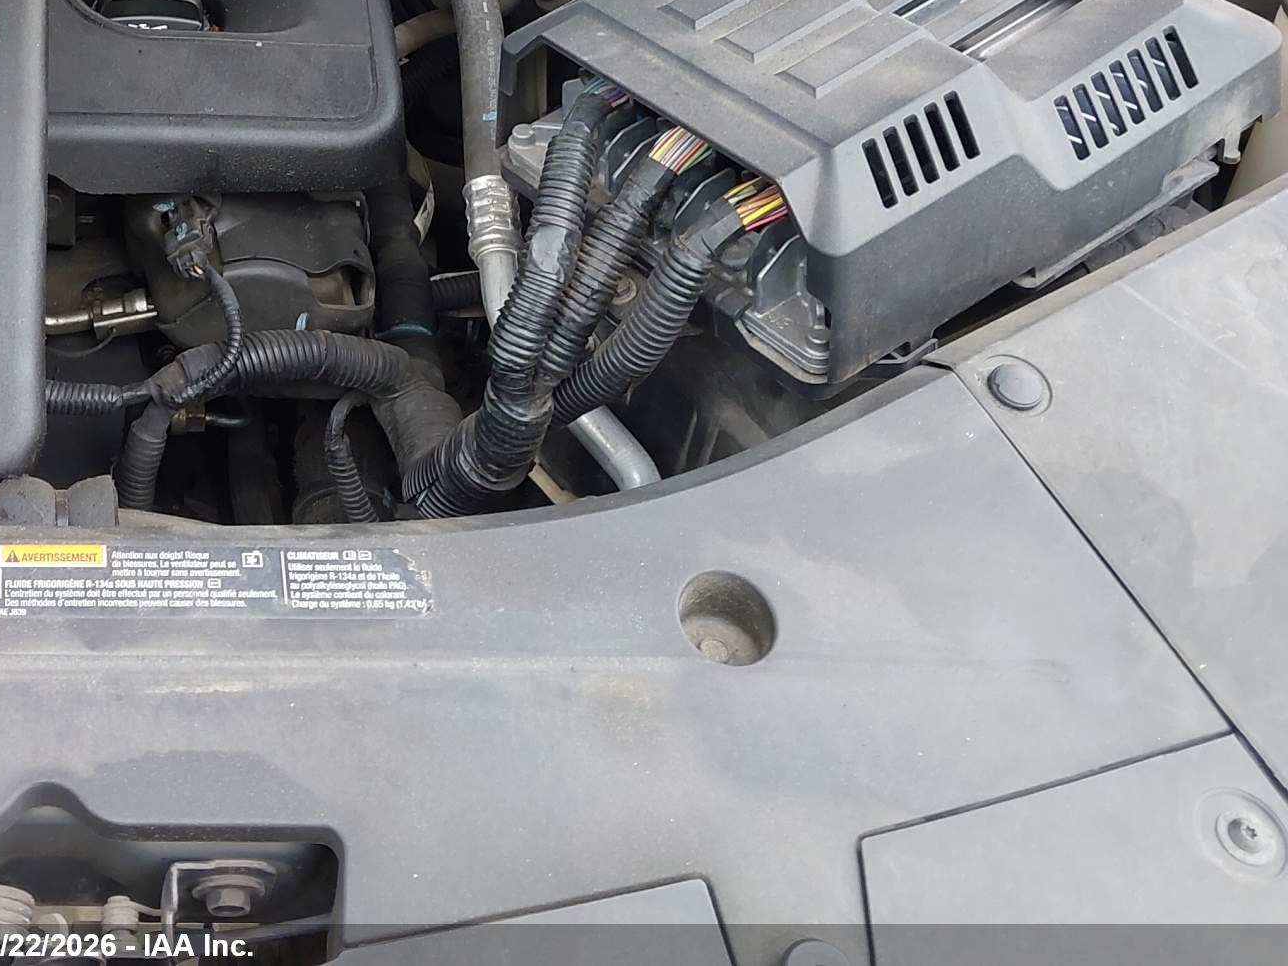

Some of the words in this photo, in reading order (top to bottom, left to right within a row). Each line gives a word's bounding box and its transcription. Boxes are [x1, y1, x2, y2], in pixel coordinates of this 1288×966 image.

[21, 553, 98, 563] AVERTISSEMENT
[112, 551, 144, 560] Attention
[144, 551, 158, 560] aux
[184, 551, 210, 560] Risque
[286, 551, 339, 560] CLIMATISEUR
[112, 560, 122, 568] de
[160, 560, 170, 568] Le
[170, 560, 208, 568] ventilateur
[209, 560, 226, 568] peut
[227, 560, 236, 568] se
[288, 562, 314, 571] Utiliser
[314, 562, 352, 571] seulement
[353, 562, 360, 571] le
[112, 569, 136, 577] mettre
[144, 569, 170, 577] tourner
[170, 569, 188, 577] sans
[329, 572, 356, 581] R-134a
[358, 572, 366, 581] et
[366, 572, 376, 581] de
[4, 580, 32, 588] FLUIDE
[86, 580, 113, 588] R-134a
[114, 580, 136, 588] SOUS
[137, 580, 164, 588] HAUTE
[164, 580, 204, 588] PRESSION
[290, 582, 300, 591] au
[44, 590, 53, 598] du
[54, 590, 85, 598] système
[86, 590, 100, 598] doit
[102, 590, 116, 598] être
[148, 590, 161, 598] par
[162, 590, 172, 598] un
[173, 590, 209, 598] personnel
[290, 590, 300, 600] Le
[333, 590, 363, 600] contient
[364, 590, 374, 600] du
[4, 598, 20, 607] Des
[98, 598, 138, 607] incorrectes
[139, 598, 168, 607] peuvent
[169, 598, 194, 607] causer
[195, 598, 209, 607] des
[292, 600, 318, 609] Charge
[319, 600, 330, 609] du
[384, 600, 395, 609] kg
